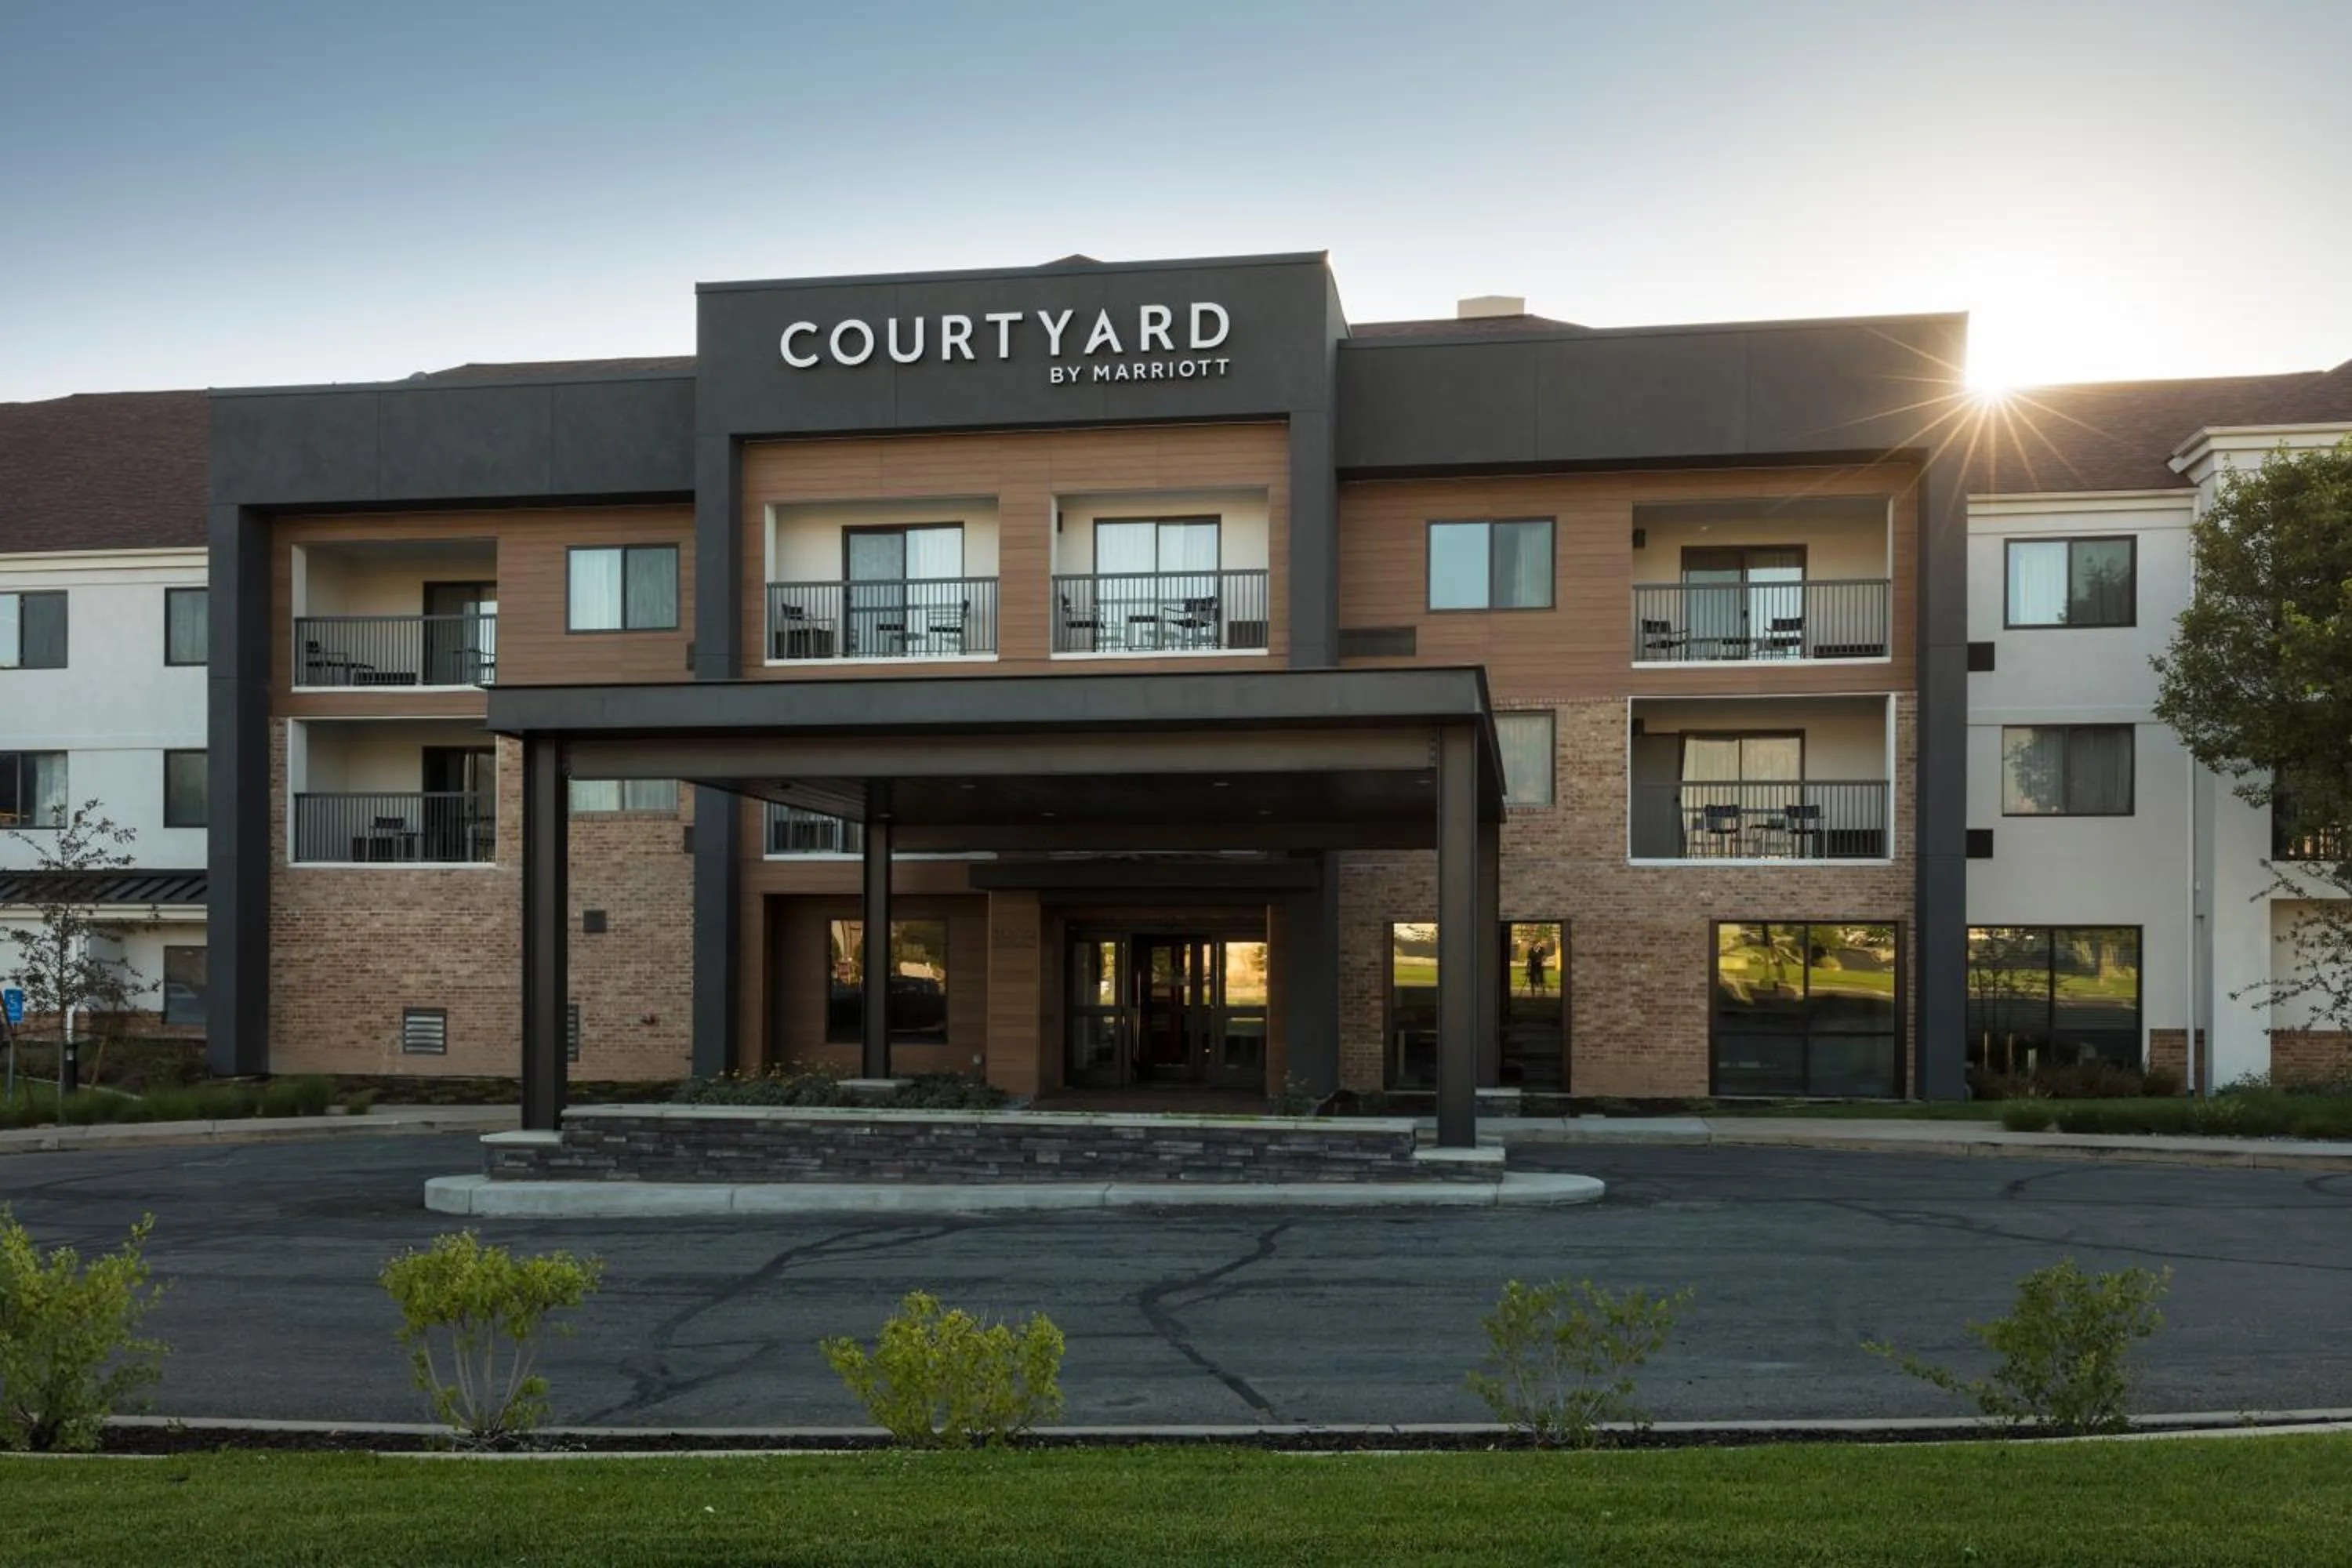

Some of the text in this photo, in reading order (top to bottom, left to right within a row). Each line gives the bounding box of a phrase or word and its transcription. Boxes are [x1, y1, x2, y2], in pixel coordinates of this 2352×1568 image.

[779, 302, 1230, 368] COURTYARD
[1051, 358, 1230, 383] BY MARRIOTT
